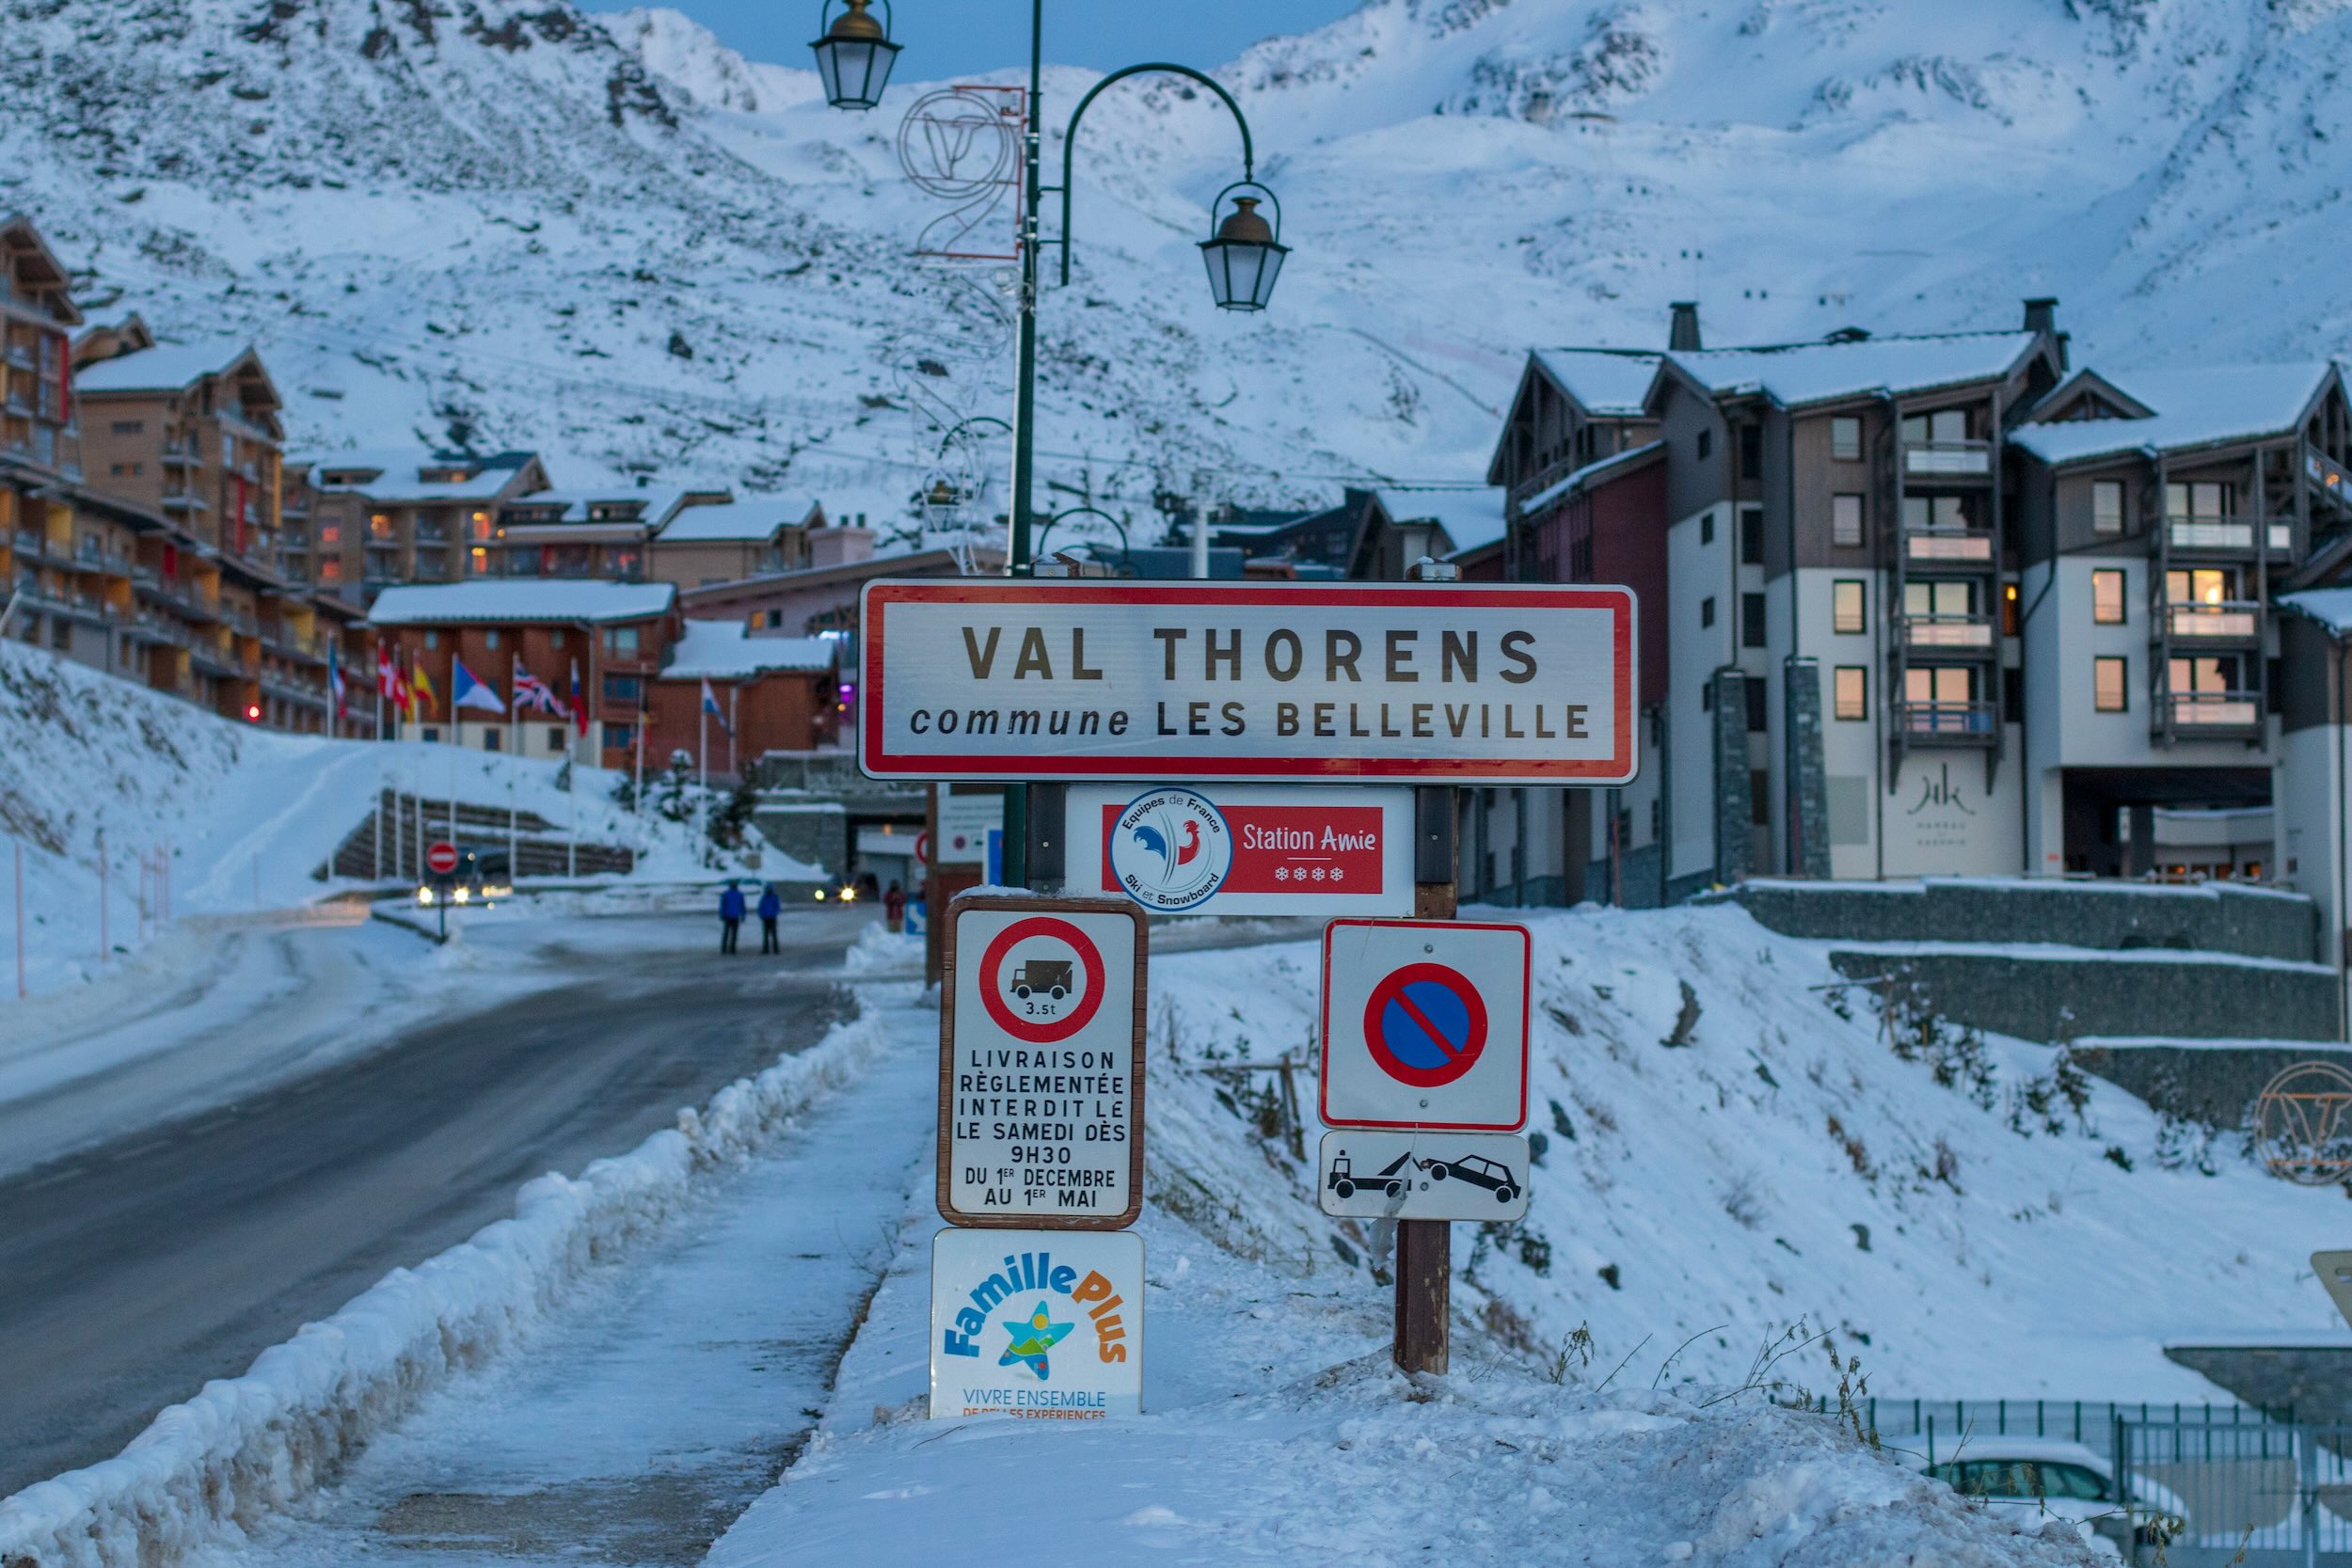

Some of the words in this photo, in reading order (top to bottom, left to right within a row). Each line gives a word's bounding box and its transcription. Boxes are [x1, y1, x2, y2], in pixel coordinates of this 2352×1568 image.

[961, 626, 1103, 680] VAL
[1153, 627, 1537, 684] THORENS
[910, 708, 1129, 736] commune
[1157, 701, 1246, 736] LES
[1277, 702, 1589, 738] BELLEVILLE
[1121, 796, 1166, 831] Equipes
[1168, 794, 1184, 806] de
[1186, 798, 1220, 834] France
[1242, 823, 1314, 850] Station
[1320, 824, 1376, 852] Amie
[1124, 873, 1143, 894] Ski
[1142, 889, 1154, 902] et
[1156, 872, 1220, 906] Snowboard
[1025, 1002, 1057, 1015] 3.5t
[971, 1050, 1114, 1069] LIVRAISON
[960, 1070, 1124, 1095] RÈGLEMENTÉE
[960, 1098, 1084, 1117] INTERDIT
[1095, 1100, 1123, 1118] LE
[957, 1121, 980, 1140] LE
[993, 1122, 1073, 1141] SAMEDI
[1086, 1120, 1126, 1142] DÈS
[1011, 1145, 1072, 1164] 9H30
[965, 1167, 987, 1185] DU
[1024, 1168, 1116, 1188] DECEMBRE
[984, 1188, 1012, 1206] AU
[1058, 1190, 1097, 1208] MAI
[944, 1252, 1077, 1358] Famille
[1071, 1269, 1126, 1363] Plus
[962, 1388, 1012, 1405] VIVRE
[1017, 1389, 1106, 1407] ENSEMBLE
